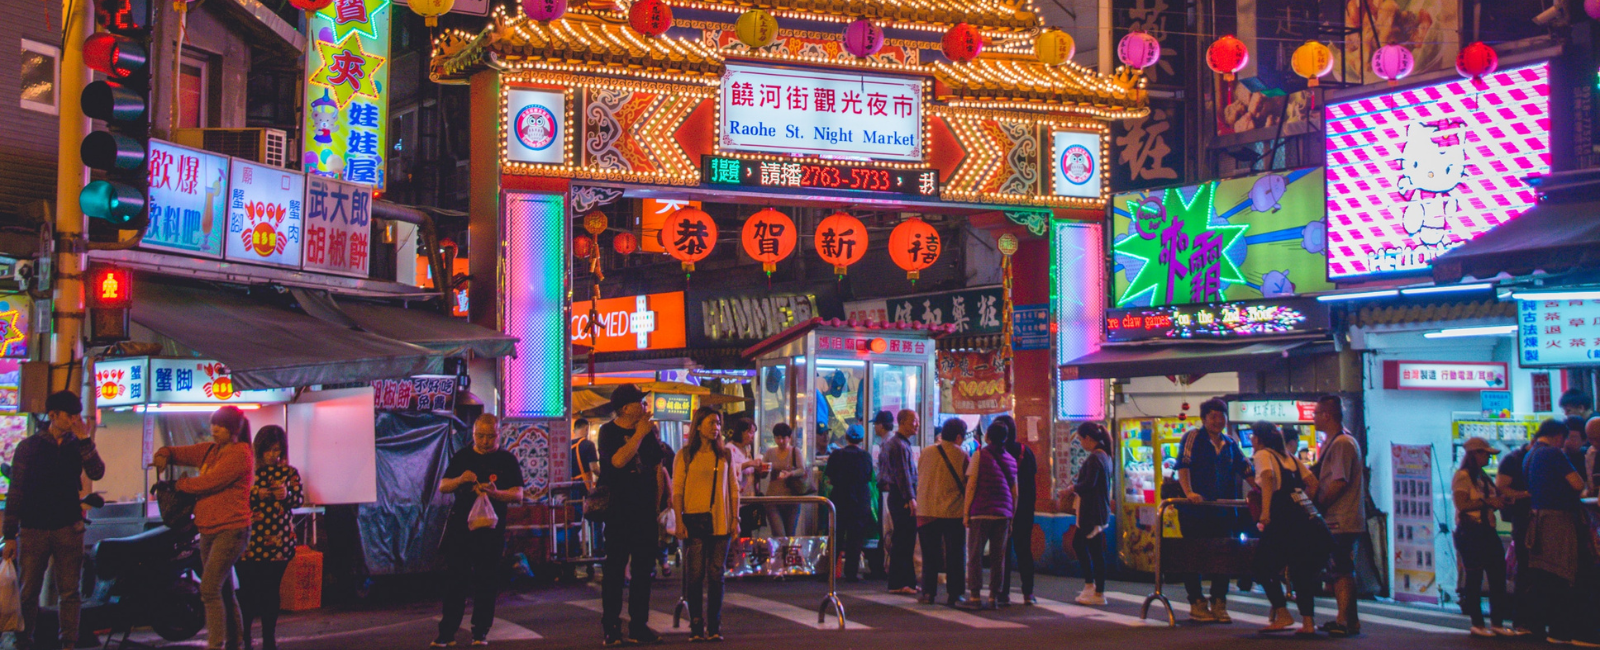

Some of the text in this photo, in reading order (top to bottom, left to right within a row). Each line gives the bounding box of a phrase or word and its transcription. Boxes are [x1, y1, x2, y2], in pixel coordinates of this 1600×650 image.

[327, 50, 365, 92] 夾
[731, 81, 914, 119] 饒河街觀光夜市
[346, 101, 379, 184] 娃娃屋
[729, 120, 915, 147] Raohe St. Night Market
[309, 182, 369, 227] 武大郎
[306, 224, 368, 271] 胡椒餅
[674, 219, 709, 255] 恭
[753, 220, 786, 256] 賀
[821, 228, 855, 259] 新
[908, 233, 939, 263] 禧
[571, 311, 629, 341] COMED
[1122, 314, 1141, 328] claw
[1144, 315, 1170, 330] games
[1198, 310, 1214, 324] the
[889, 339, 925, 354] 服務台
[414, 378, 454, 394] 不好吃
[1403, 369, 1437, 380] 台灣製造
